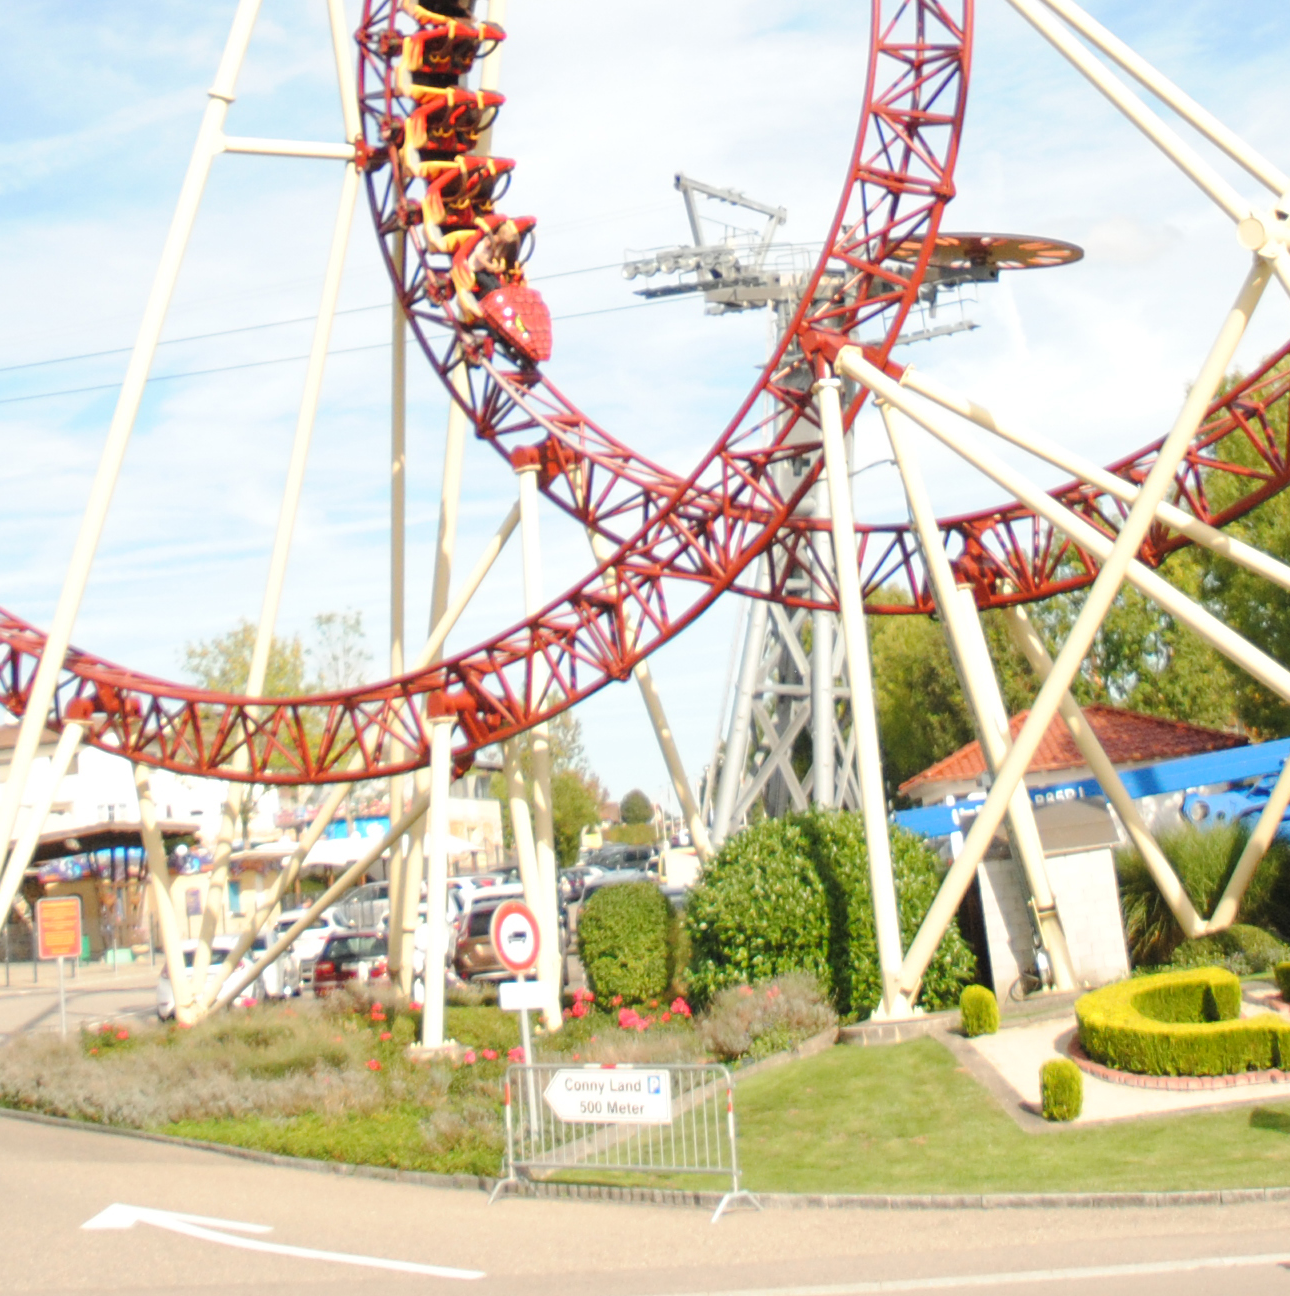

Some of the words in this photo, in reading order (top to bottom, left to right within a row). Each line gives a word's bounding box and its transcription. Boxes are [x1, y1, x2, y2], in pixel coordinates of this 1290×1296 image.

[564, 1077, 605, 1095] Conny
[610, 1077, 641, 1092] Land
[580, 1101, 603, 1113] 500
[607, 1101, 645, 1115] Meter
